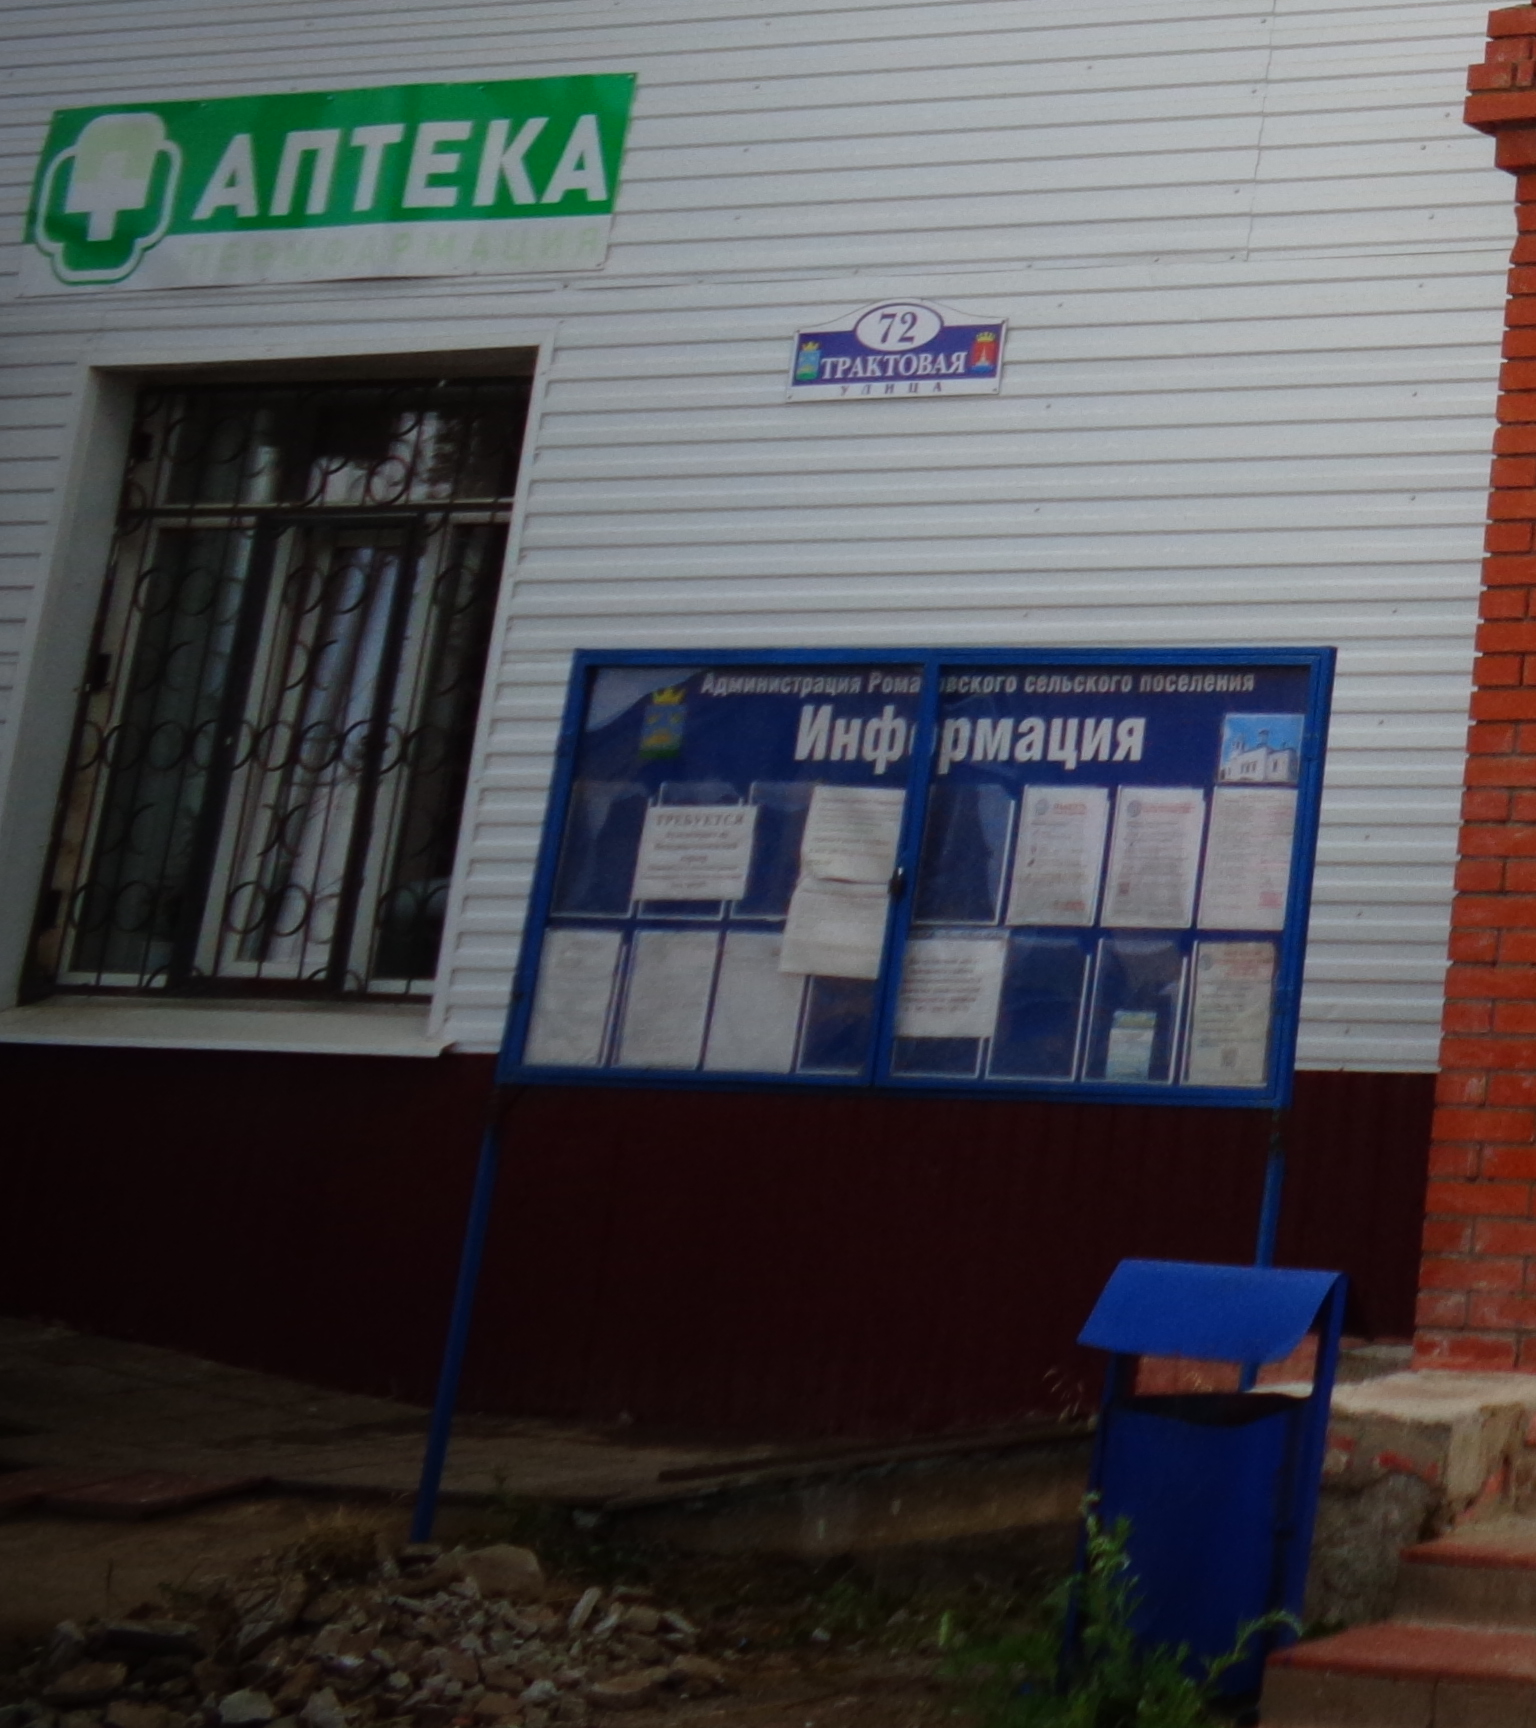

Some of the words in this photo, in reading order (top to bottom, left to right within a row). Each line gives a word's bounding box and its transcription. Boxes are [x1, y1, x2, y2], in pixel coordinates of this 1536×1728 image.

[191, 114, 609, 220] АПТЕКА
[878, 311, 918, 345] 72
[821, 351, 968, 380] ТРАКТОВАЯ
[840, 381, 942, 396] УЛИЦА
[701, 673, 861, 698] Администрация
[1024, 673, 1133, 693] сельского
[1139, 672, 1255, 693] поселения
